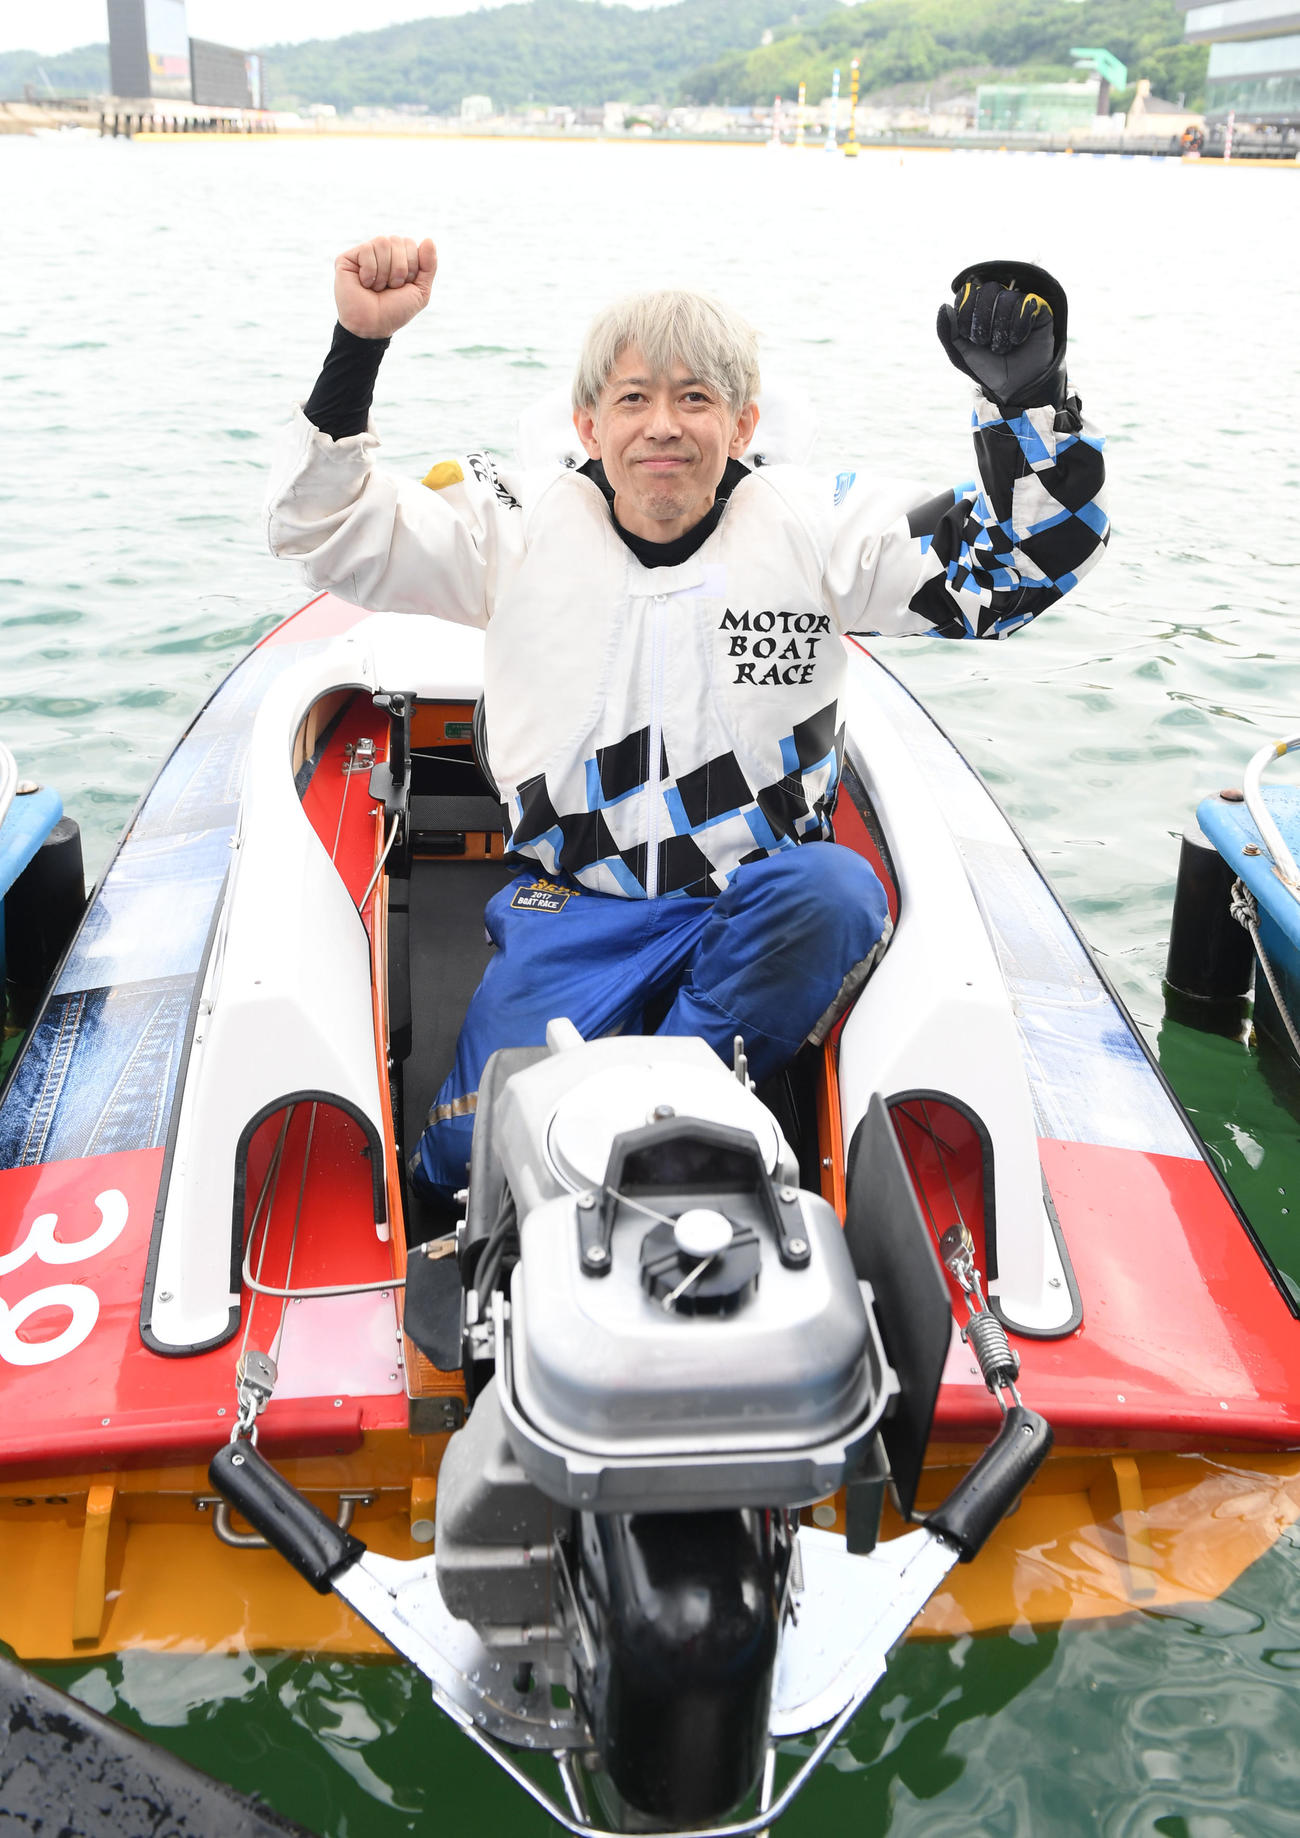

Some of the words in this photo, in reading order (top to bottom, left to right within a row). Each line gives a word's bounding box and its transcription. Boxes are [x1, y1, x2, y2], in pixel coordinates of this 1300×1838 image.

[718, 608, 831, 634] MOTOR
[727, 635, 821, 660] BOAT
[732, 662, 816, 686] RACE
[517, 897, 538, 907] BOAT
[537, 899, 559, 909] RACE
[530, 891, 553, 900] 2017
